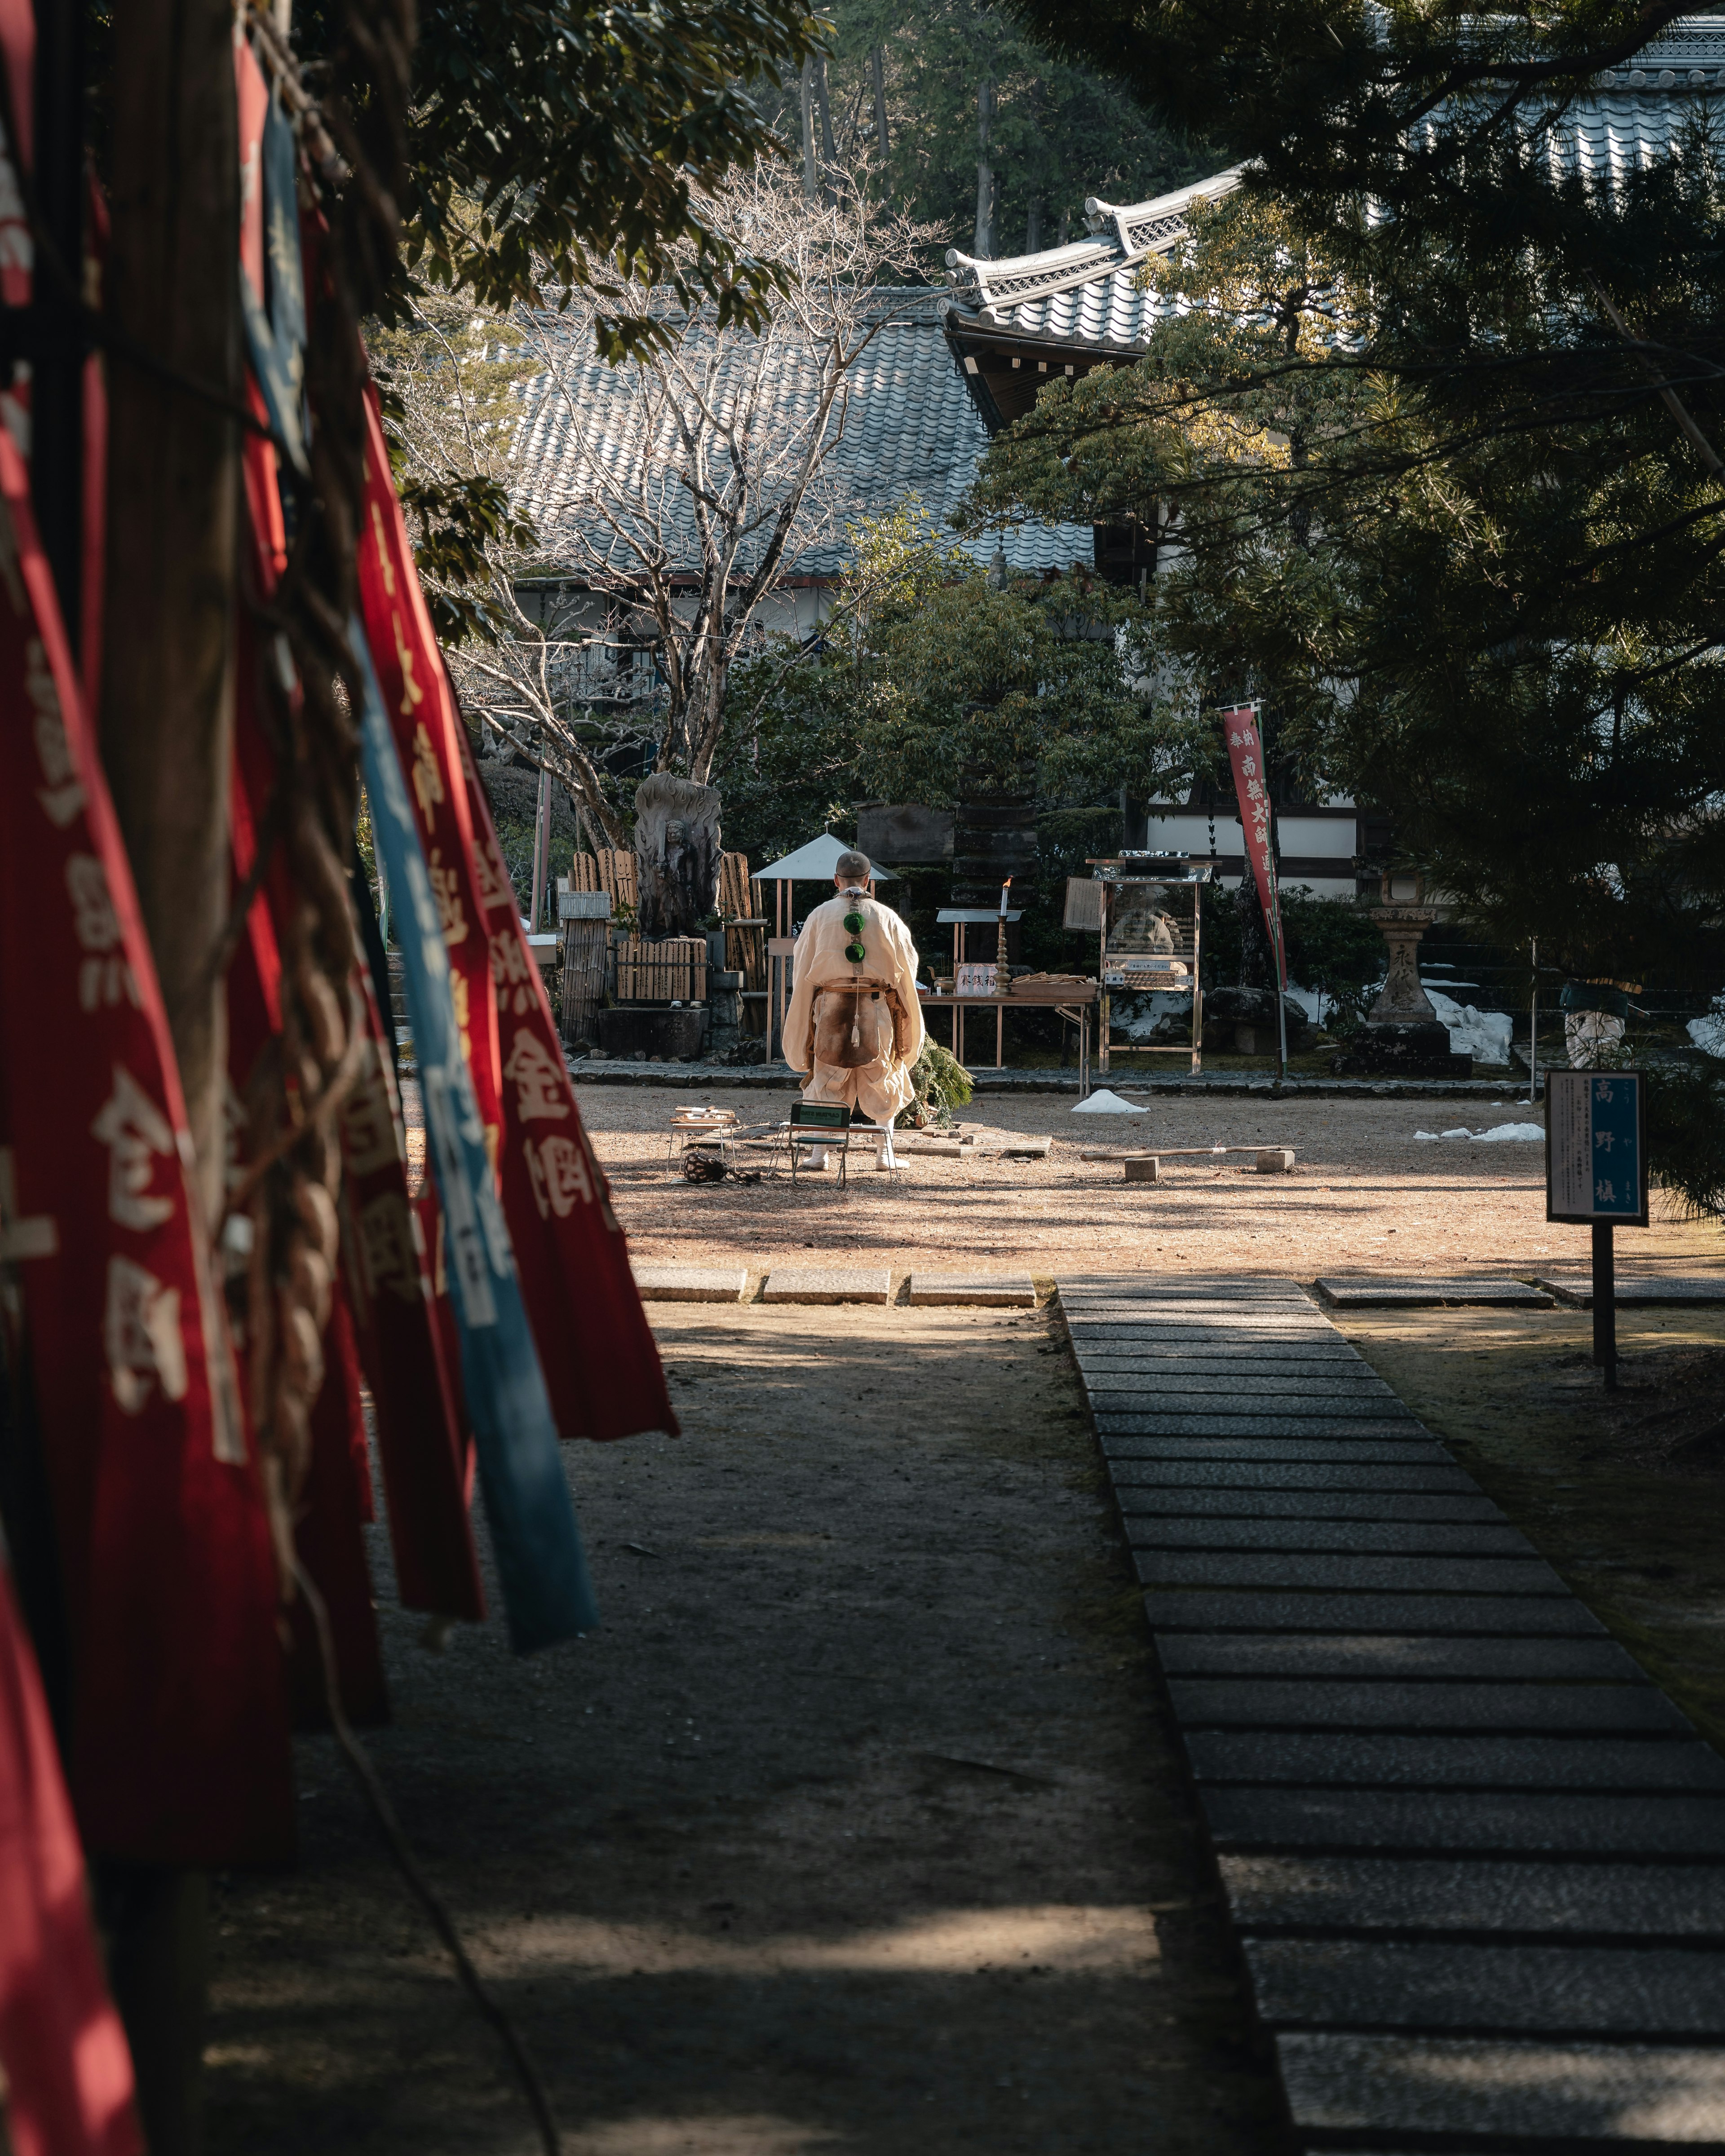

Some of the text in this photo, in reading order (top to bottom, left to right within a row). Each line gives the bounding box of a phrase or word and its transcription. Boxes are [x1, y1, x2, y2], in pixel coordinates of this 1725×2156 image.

[1230, 729, 1254, 748] 奉納
[960, 974, 995, 987] 賽銭箱
